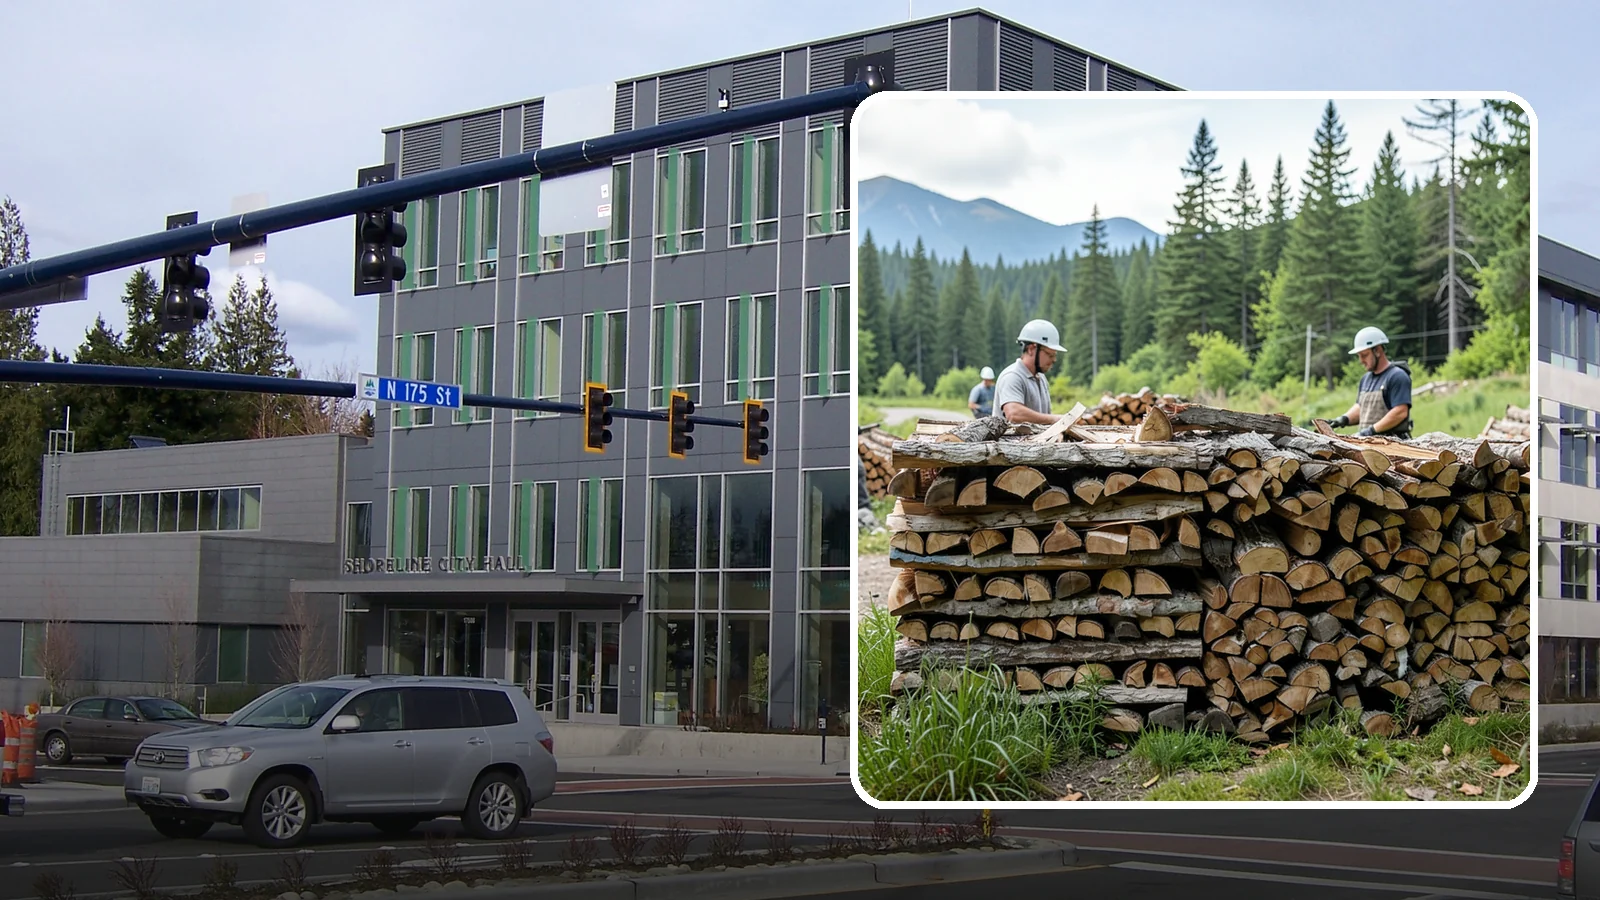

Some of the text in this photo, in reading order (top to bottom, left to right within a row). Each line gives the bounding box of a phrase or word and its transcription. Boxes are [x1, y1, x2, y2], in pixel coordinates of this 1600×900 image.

[387, 381, 451, 406] N 175 St
[344, 556, 525, 574] SHORELINE CITY HALL
